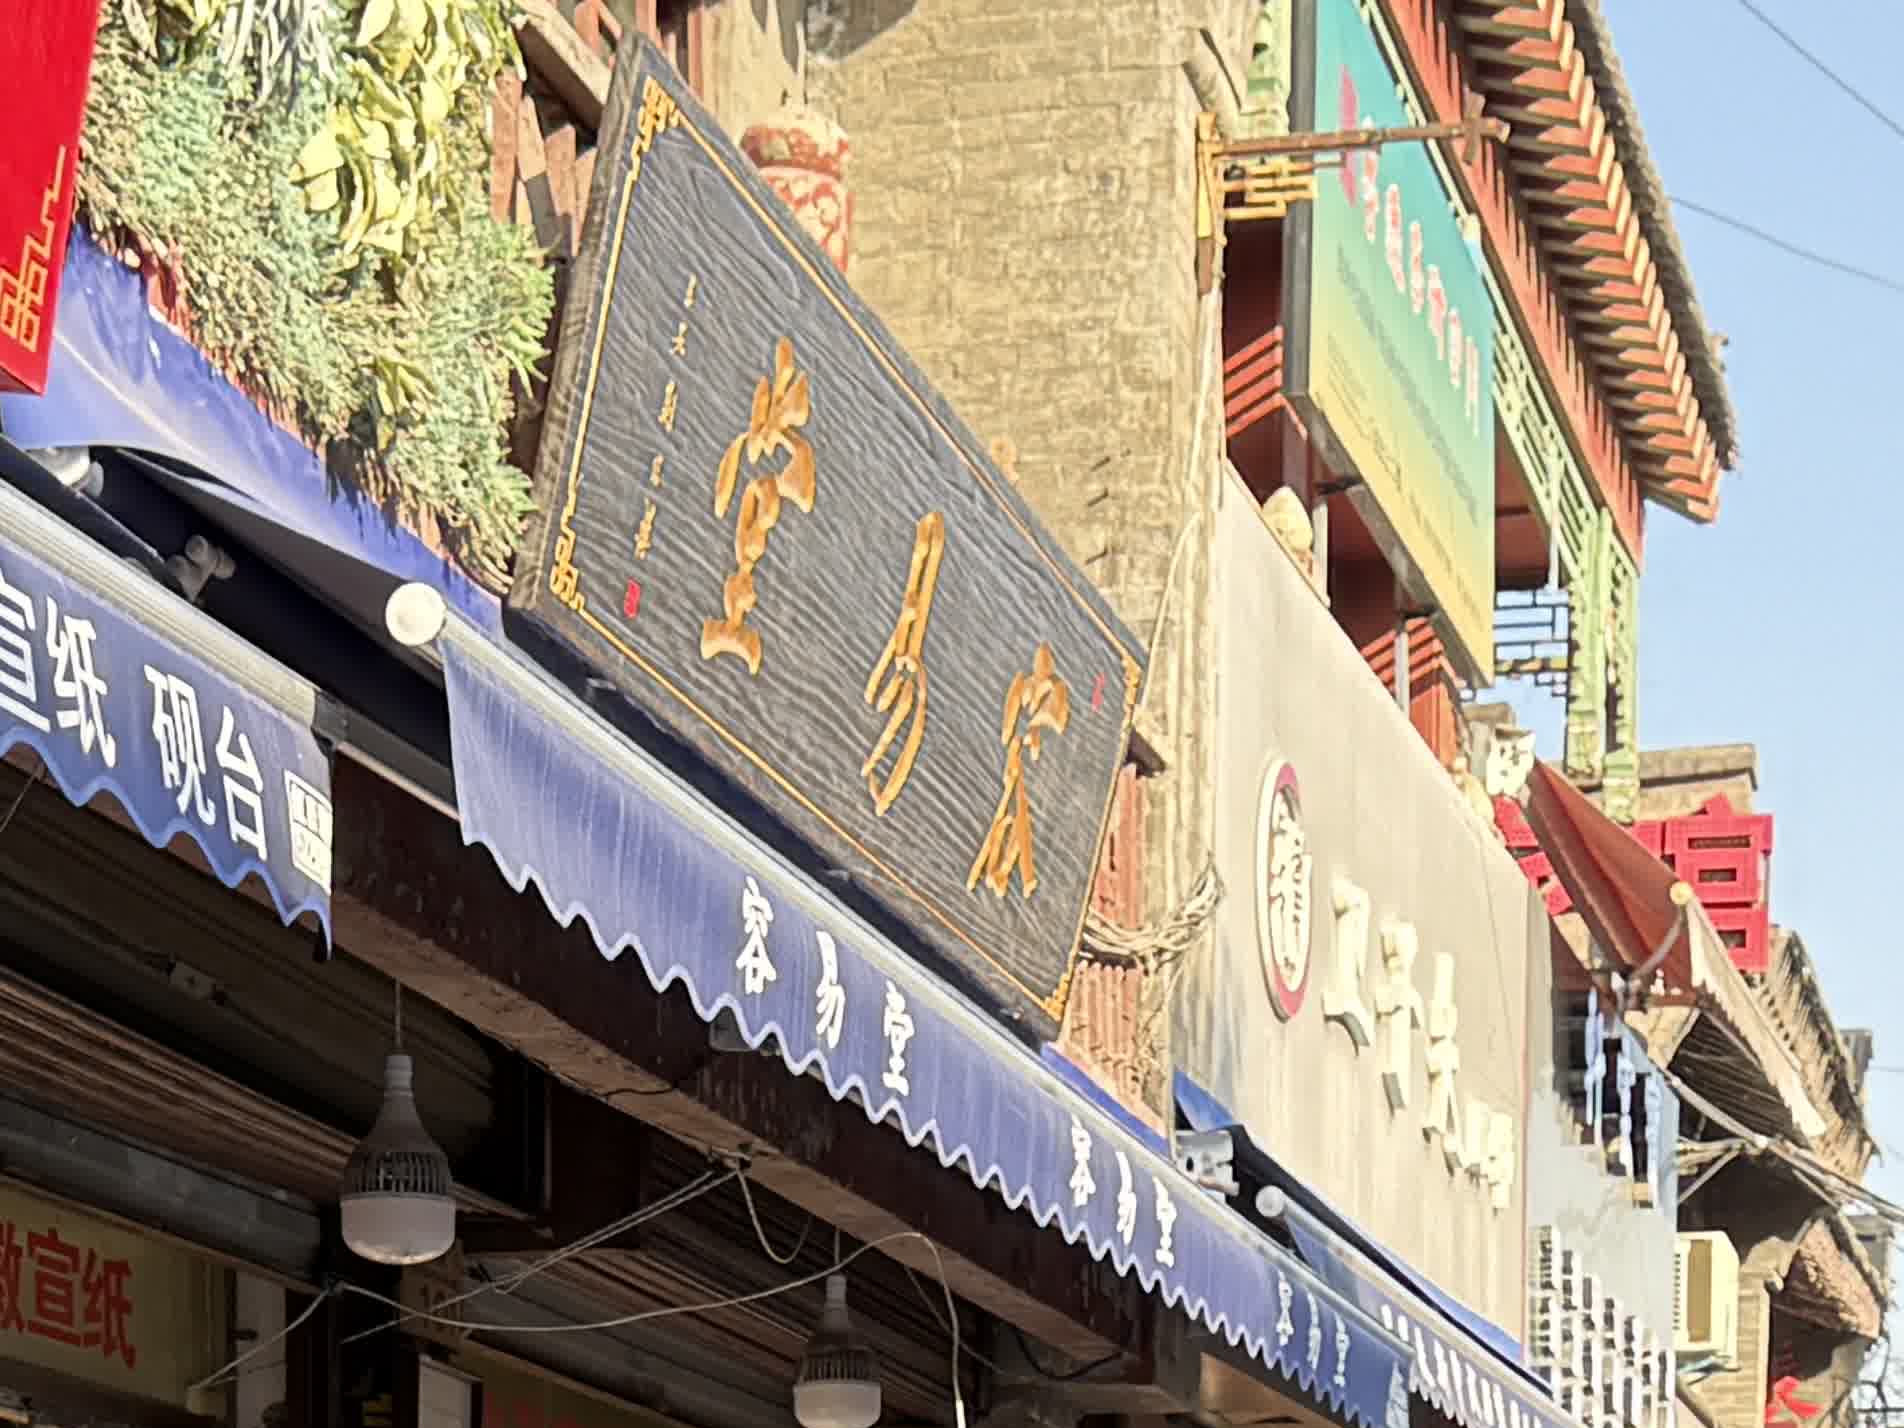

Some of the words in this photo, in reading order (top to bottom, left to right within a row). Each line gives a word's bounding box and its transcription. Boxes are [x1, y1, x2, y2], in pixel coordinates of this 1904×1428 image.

[143, 663, 269, 861] 砚台
[735, 876, 914, 1095] 容易堂
[1069, 1115, 1177, 1270] 容易堂
